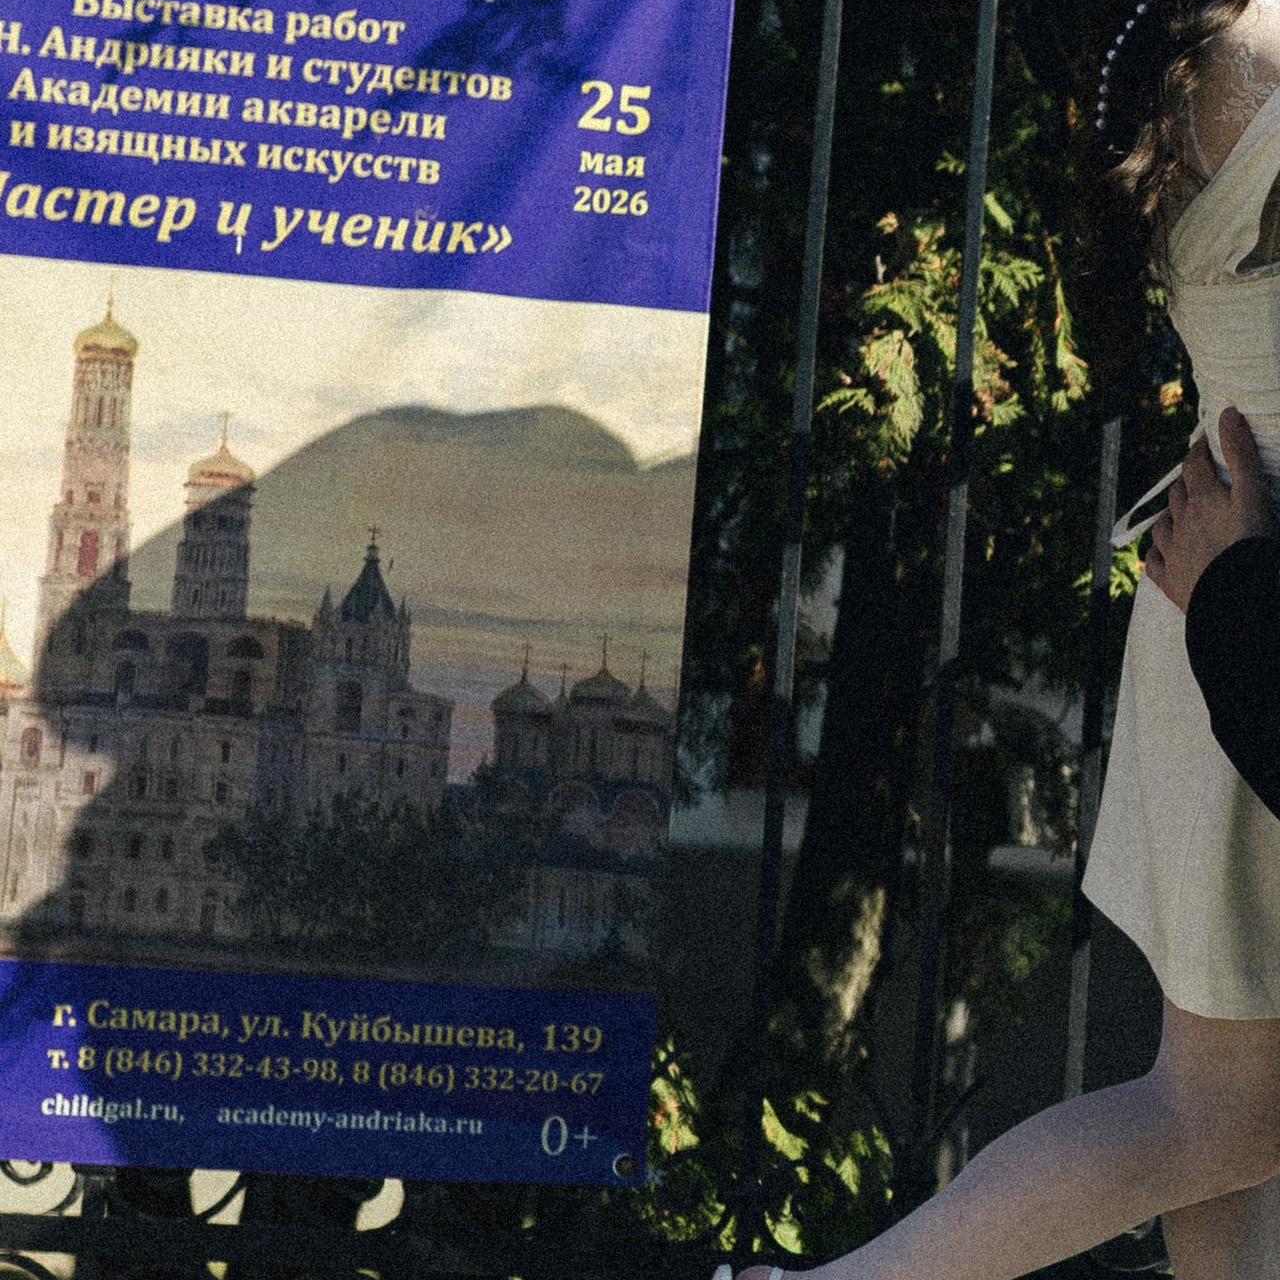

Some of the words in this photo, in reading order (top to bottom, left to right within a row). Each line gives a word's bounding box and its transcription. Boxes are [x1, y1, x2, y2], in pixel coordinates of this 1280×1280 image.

[285, 9, 406, 45] работ
[38, 25, 256, 76] Андрияки
[265, 53, 293, 81] и
[302, 56, 513, 101] студентов
[8, 67, 232, 120] Академии
[242, 96, 447, 140] акварели
[577, 80, 652, 135] 25
[9, 120, 36, 148] и
[46, 122, 249, 167] изящных
[257, 141, 442, 185] искусств
[579, 150, 646, 177] мая
[573, 185, 649, 216] 2026
[216, 200, 252, 237] и
[261, 204, 513, 254] ученик»
[52, 1002, 77, 1027] г.
[87, 999, 230, 1040] Самара,
[237, 1014, 290, 1043] ул.
[301, 1011, 525, 1053] Куйбышева,
[542, 1023, 604, 1053] 139
[47, 1048, 70, 1070] т.
[76, 1046, 96, 1070] 8
[105, 1047, 183, 1080] (846)
[192, 1051, 344, 1085] 332-43-98,
[352, 1060, 371, 1085] 8
[378, 1062, 456, 1094] (846)
[464, 1066, 605, 1095] 332-20-67
[40, 1093, 185, 1124] childgal.ru,
[217, 1104, 484, 1135] academy-andriaka.ru
[541, 1115, 598, 1156] 0+
